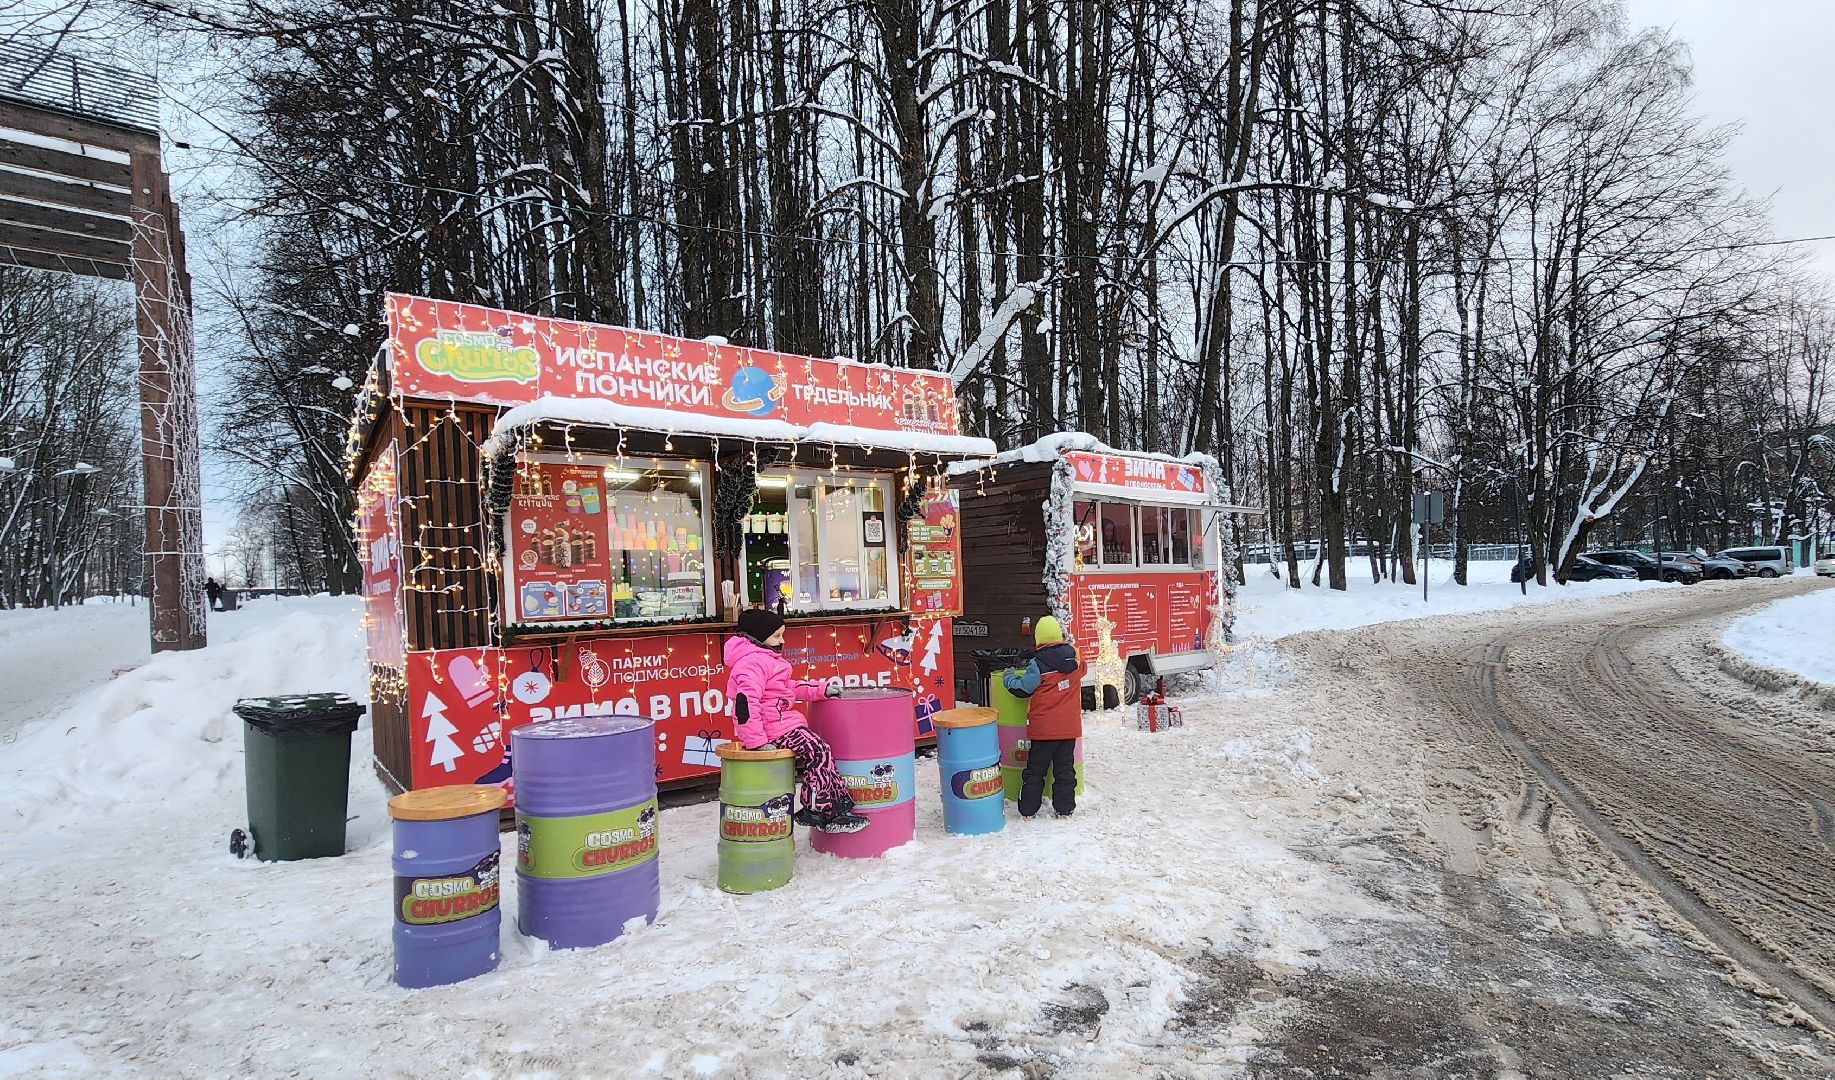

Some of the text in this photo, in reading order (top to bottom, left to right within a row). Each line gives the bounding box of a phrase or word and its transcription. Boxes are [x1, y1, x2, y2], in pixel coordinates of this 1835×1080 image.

[555, 346, 720, 386] ИСПАНСКИЕ
[575, 370, 711, 406] ПОНЧИКИ
[1124, 458, 1167, 480] ЗИМА
[613, 656, 663, 670] ПАРКИ
[613, 664, 725, 685] ПОДМОСКОВЬЯ
[650, 694, 671, 721] В
[842, 776, 866, 787] OSMO
[726, 807, 762, 821] COSMO
[587, 828, 633, 848] COSMO
[582, 834, 655, 867] CHURROS
[415, 881, 470, 898] COSMO
[411, 884, 498, 918] CHURROS
